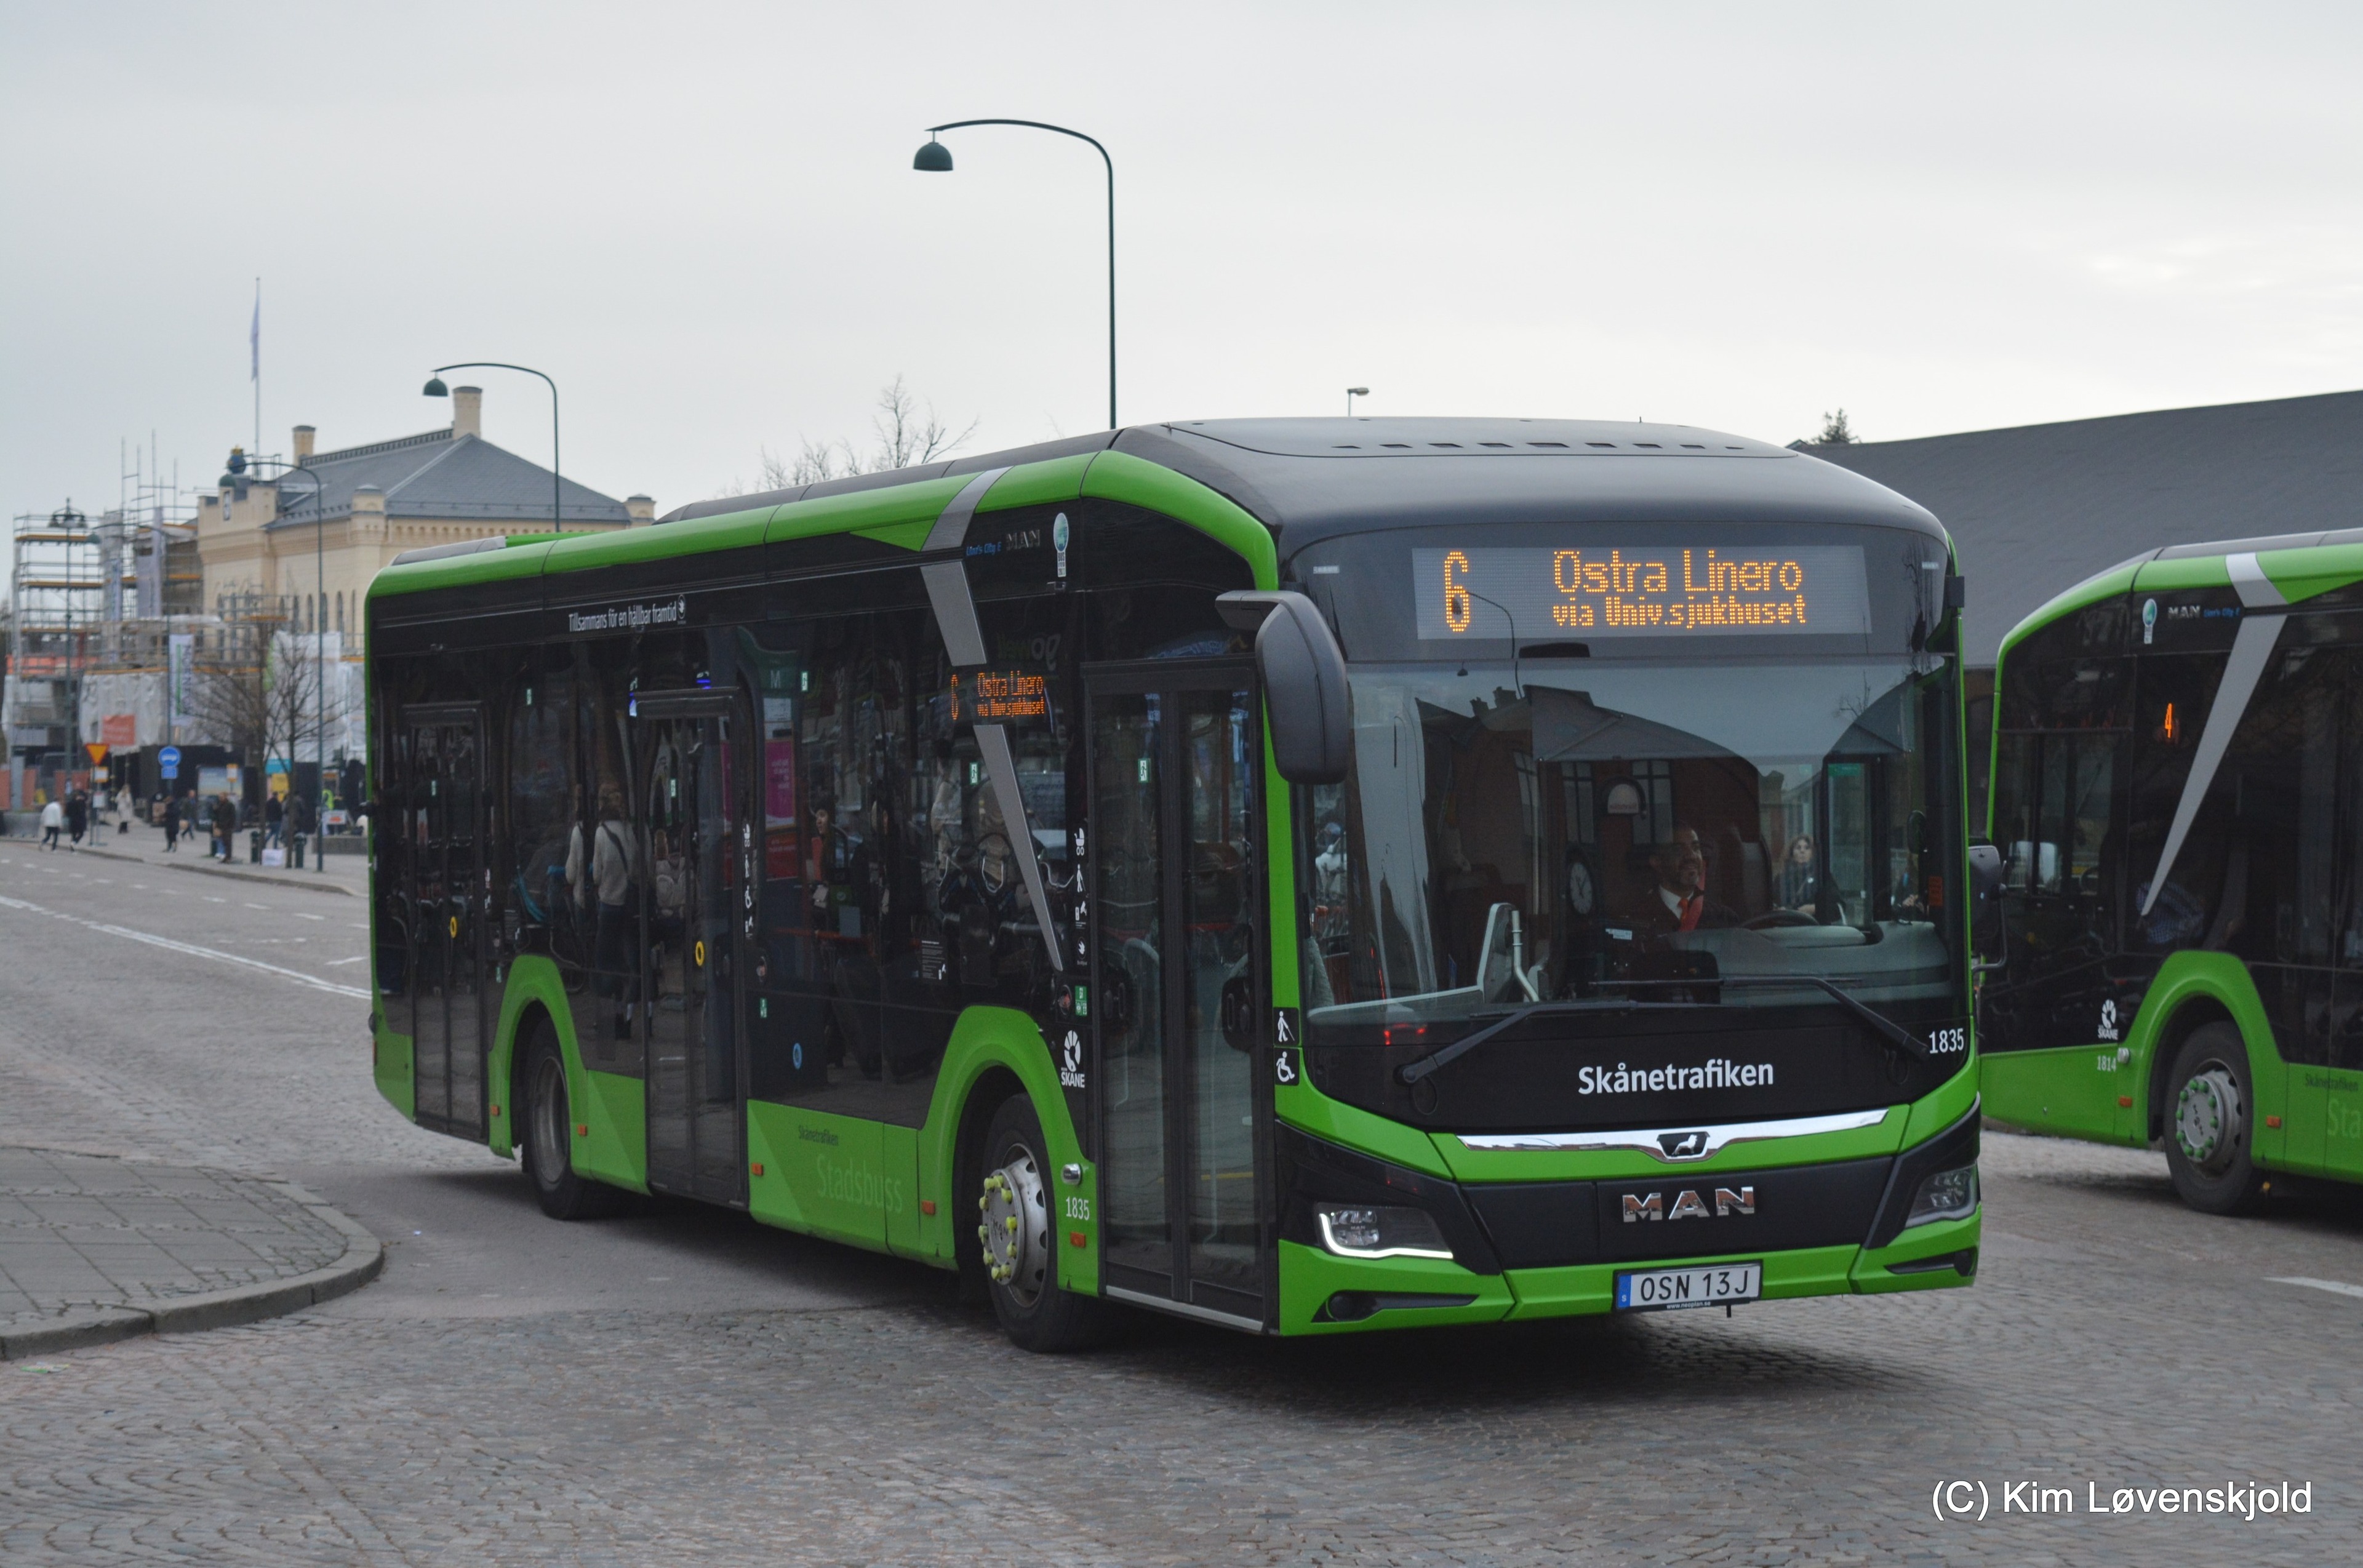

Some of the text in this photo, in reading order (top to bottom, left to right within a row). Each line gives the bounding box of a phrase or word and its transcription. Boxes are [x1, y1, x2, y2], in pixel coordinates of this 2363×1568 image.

[1006, 529, 1041, 551] MAN
[1683, 550, 1802, 591] Linero
[1444, 551, 1470, 632] 6
[569, 601, 677, 633] Tillsammans för en hållbar framtid
[1553, 594, 1807, 630] via Univ.sjukhuset
[2168, 605, 2201, 619] MAN
[951, 674, 959, 720] 6
[1010, 670, 1044, 695] Linero
[977, 699, 988, 717] via
[2165, 702, 2172, 738] 4
[1929, 1028, 1965, 1054] 1835
[1577, 1058, 1775, 1095] Skånetrafiken
[2097, 1055, 2116, 1072] 1814
[817, 1153, 903, 1214] Stadsbuss
[1066, 1196, 1090, 1220] 1835
[1622, 1186, 1755, 1223] MAN
[1621, 1294, 1627, 1303] S
[1641, 1270, 1748, 1302] OSN 13J
[1666, 1301, 1711, 1310] www.neoplan.se
